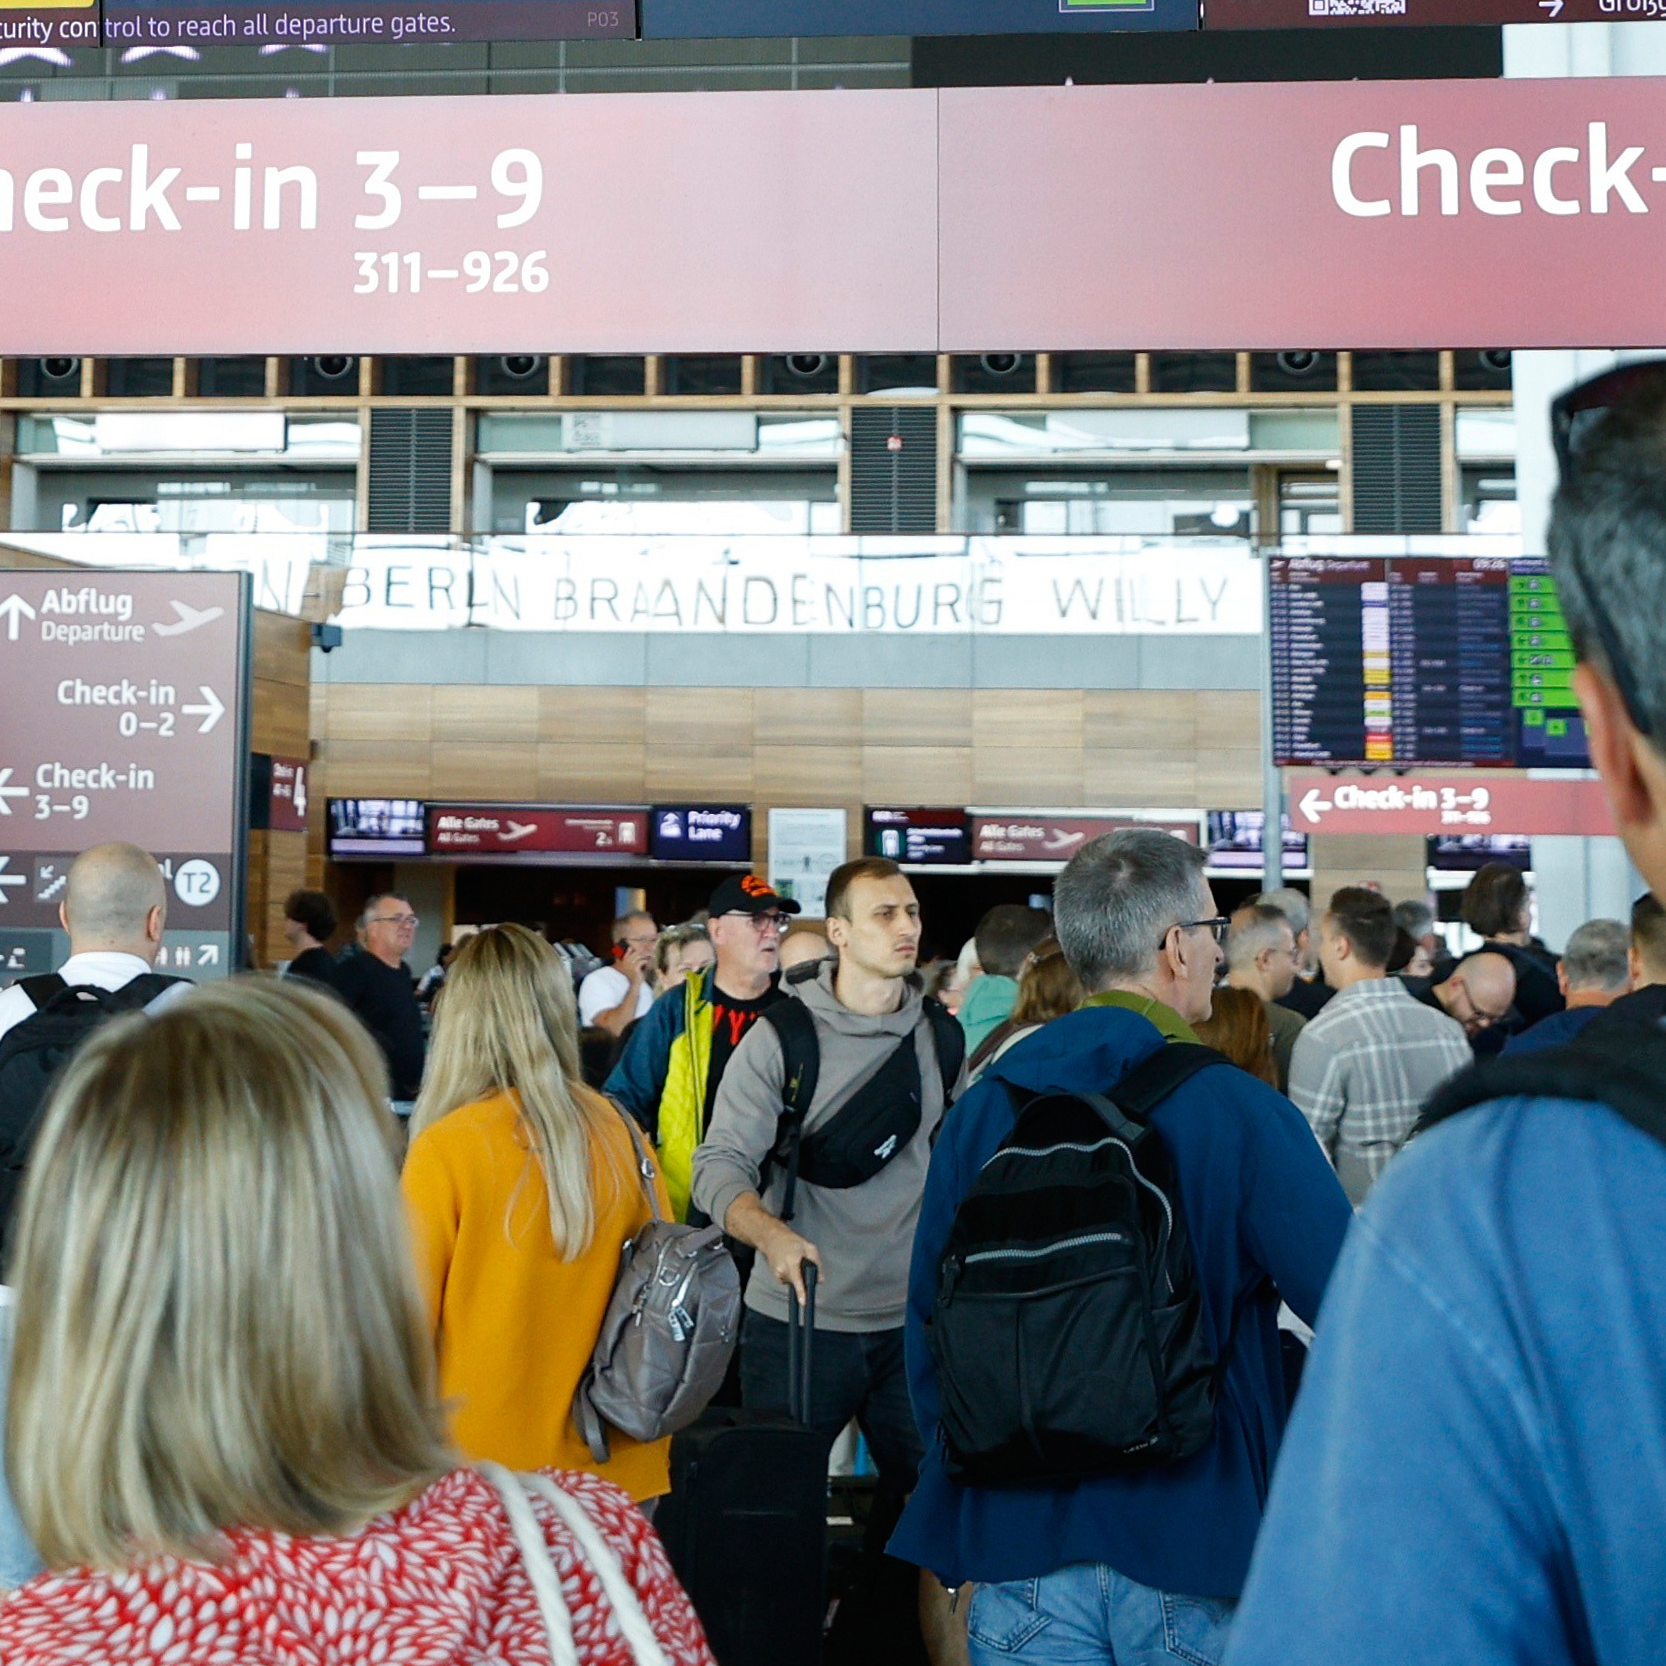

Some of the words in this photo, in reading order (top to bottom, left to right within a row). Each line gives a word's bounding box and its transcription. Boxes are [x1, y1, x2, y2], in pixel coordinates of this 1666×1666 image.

[59, 11, 141, 40] control
[148, 15, 171, 37] to
[178, 14, 235, 36] reach
[244, 14, 268, 35] all
[276, 13, 383, 40] departure
[391, 13, 455, 39] gates.
[41, 588, 132, 620] Abflug
[42, 621, 145, 645] Departure
[58, 679, 175, 705] Check-in
[37, 762, 153, 789] Check-in
[1334, 784, 1436, 810] Check-in
[1008, 825, 1045, 838] Gates
[181, 870, 212, 894] T2
